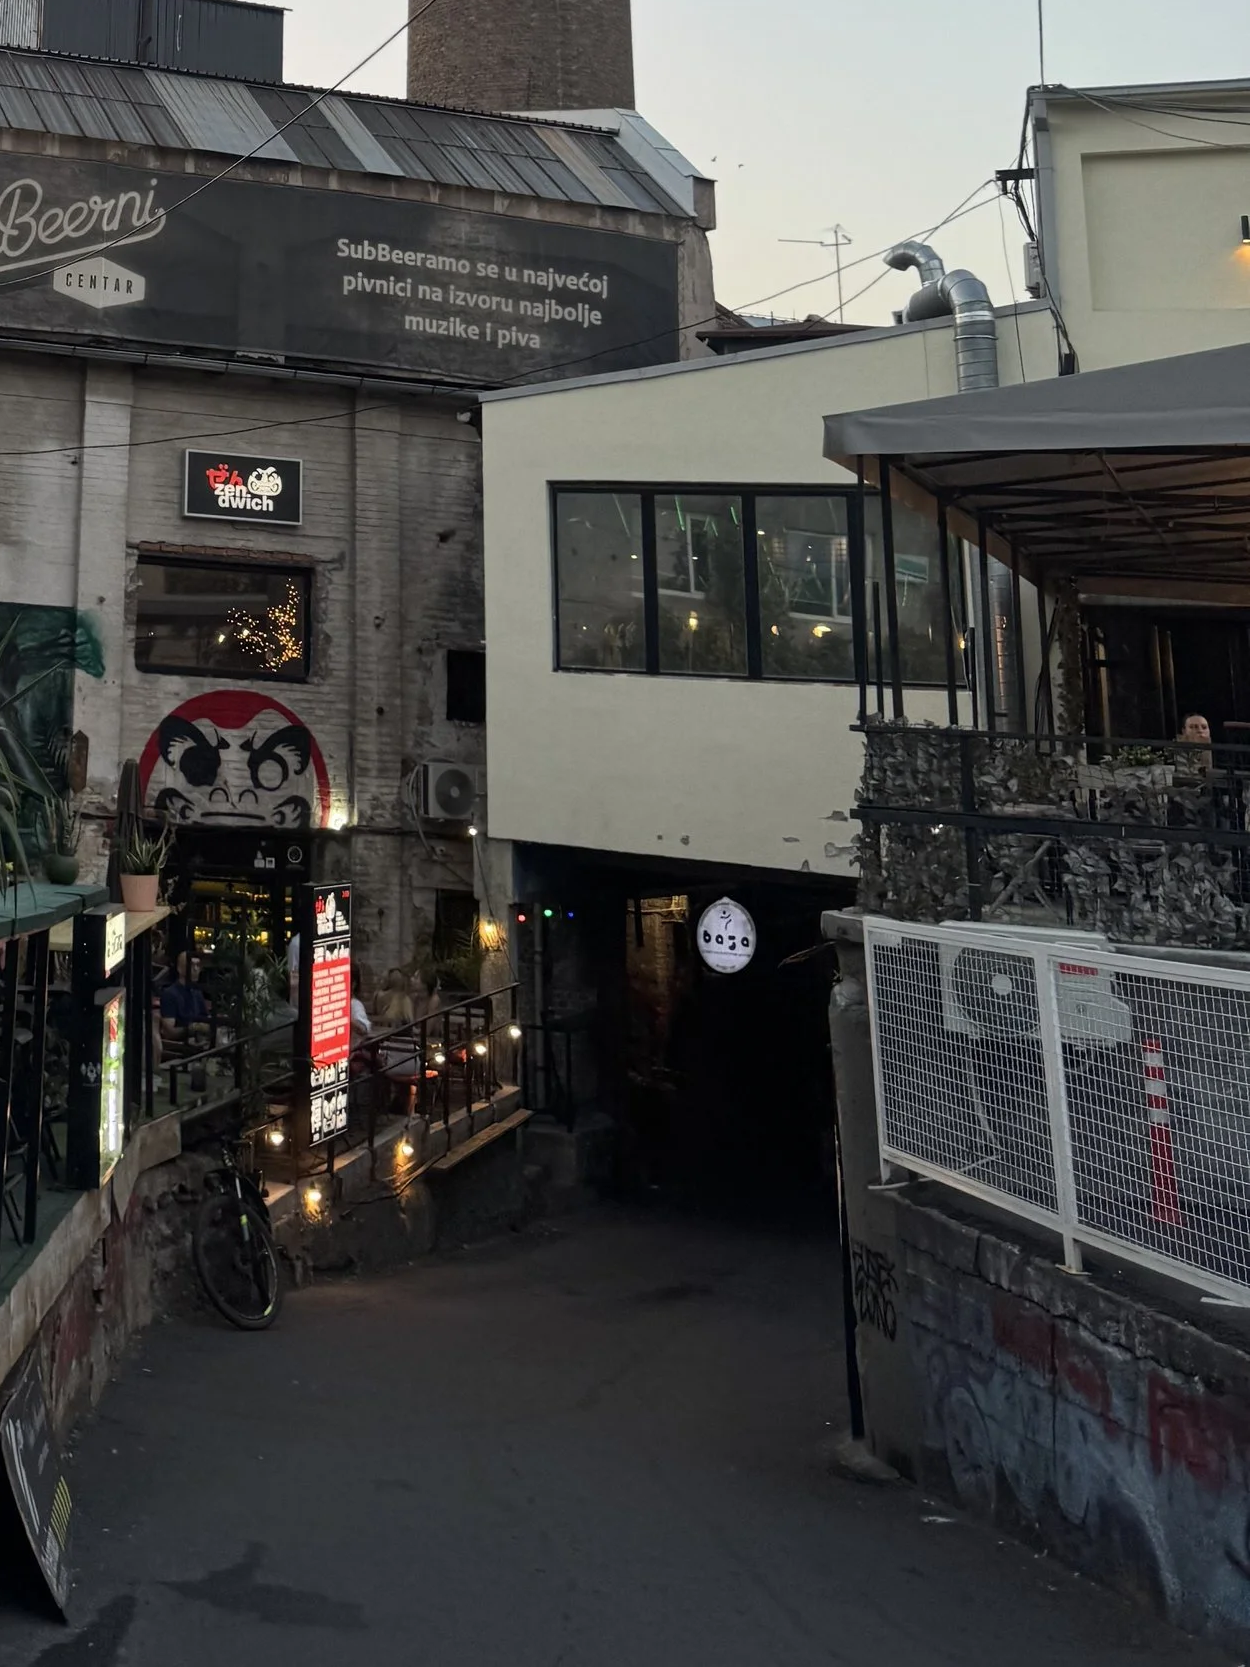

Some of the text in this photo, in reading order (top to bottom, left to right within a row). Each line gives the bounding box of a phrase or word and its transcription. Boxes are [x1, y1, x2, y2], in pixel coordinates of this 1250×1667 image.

[337, 238, 608, 299] SubBeeramo se u najvećoj
[65, 273, 133, 294] CENTAR
[343, 272, 602, 328] pivnici na izvoru najbolje
[404, 313, 541, 349] muzike i piva
[214, 483, 248, 498] zen
[218, 493, 274, 512] dwich
